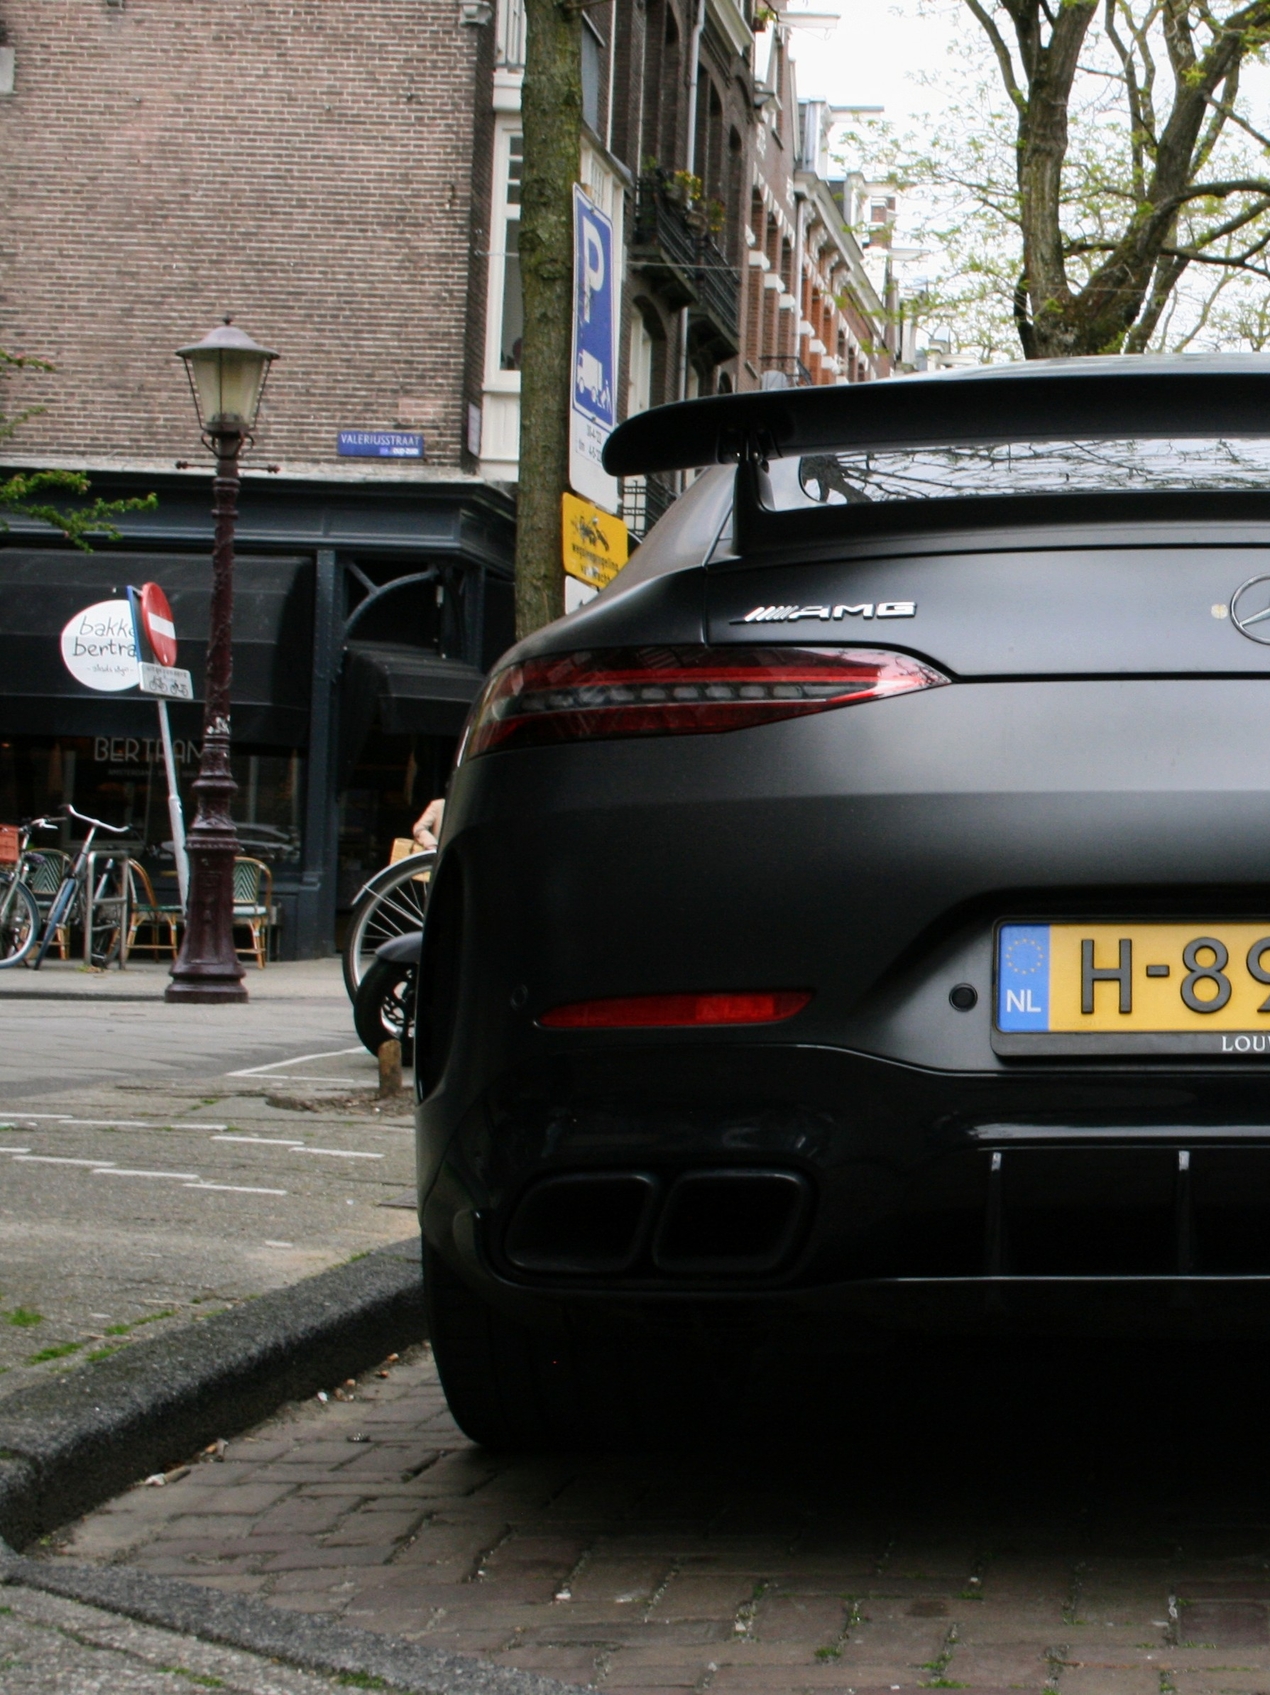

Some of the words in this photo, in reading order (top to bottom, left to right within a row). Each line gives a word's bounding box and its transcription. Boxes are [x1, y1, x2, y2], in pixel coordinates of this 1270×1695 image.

[582, 215, 605, 323] P
[341, 433, 420, 446] VALERIUSSTRAAT
[787, 602, 917, 621] AMG
[1006, 989, 1041, 1013] NL
